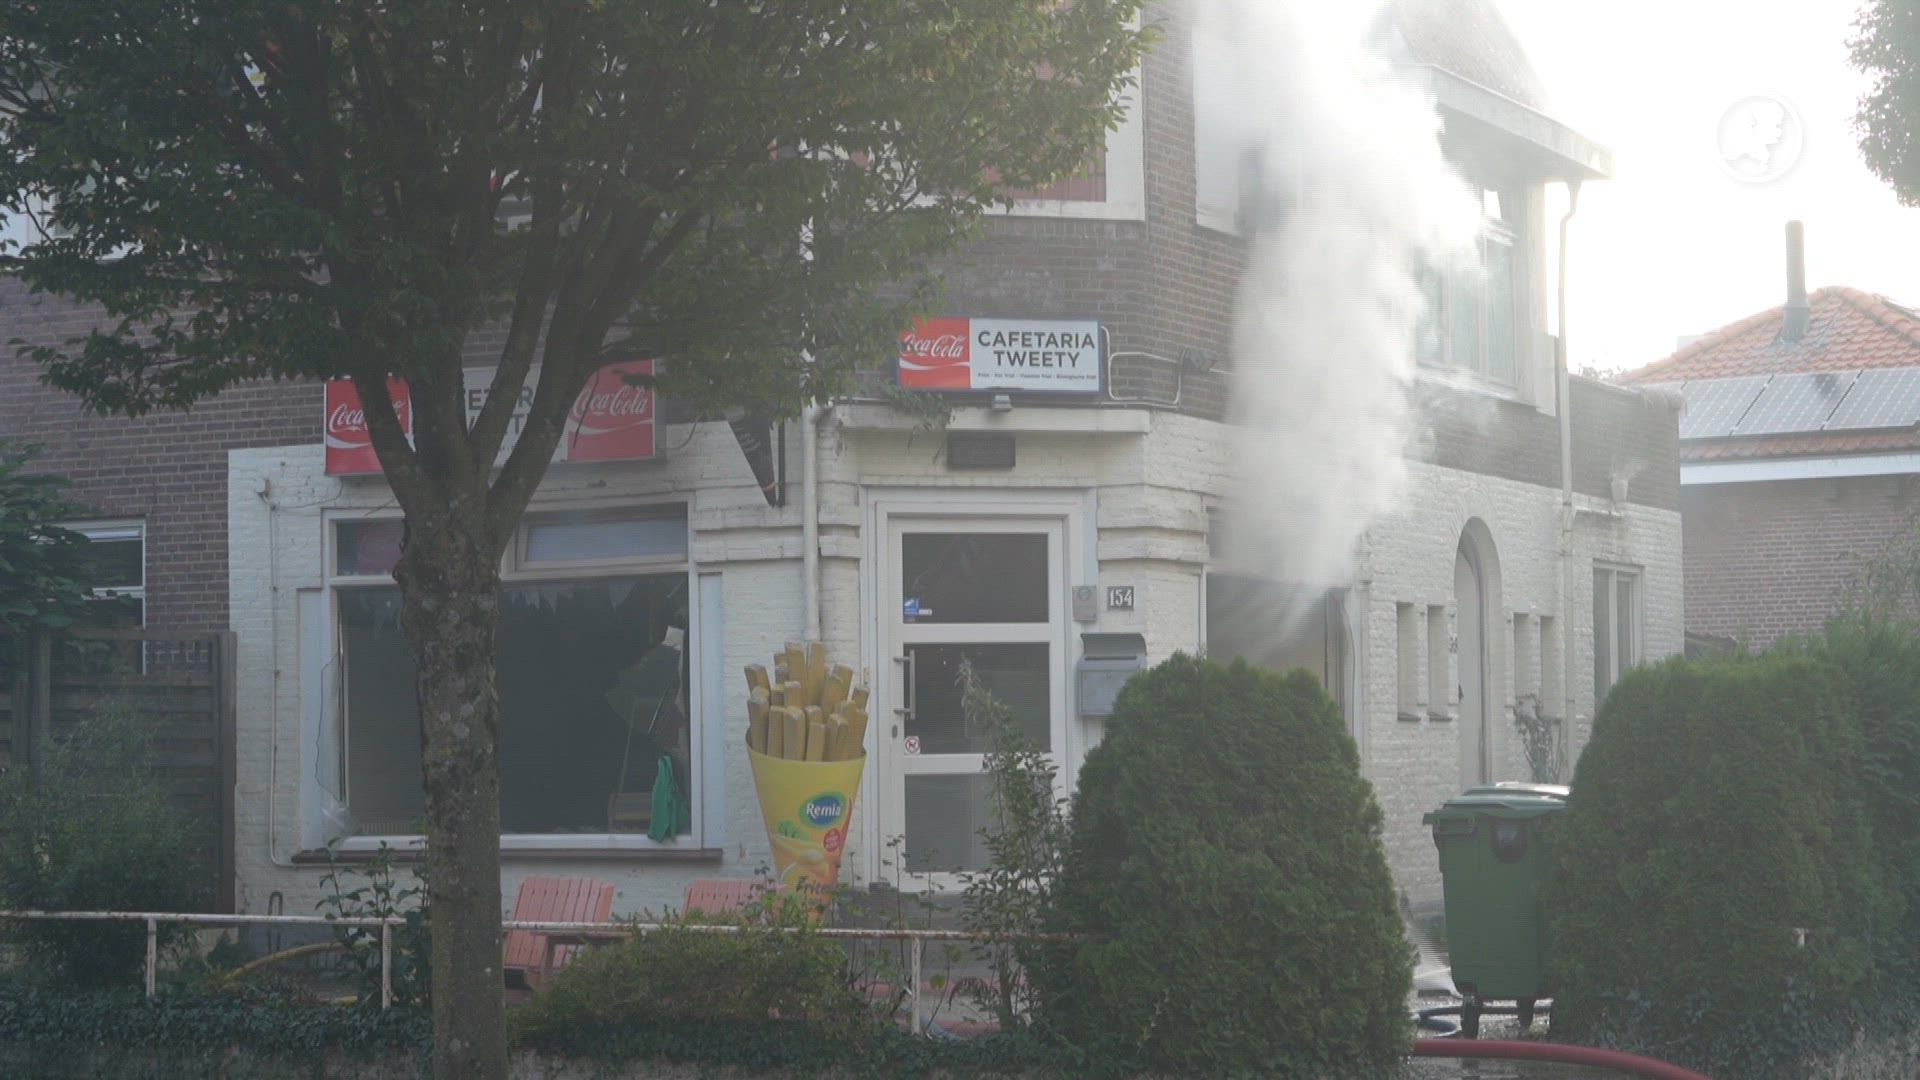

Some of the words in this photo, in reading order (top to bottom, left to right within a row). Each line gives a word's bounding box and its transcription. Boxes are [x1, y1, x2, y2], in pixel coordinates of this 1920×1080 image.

[978, 330, 1095, 349] CAFETARIA
[993, 351, 1080, 368] TWEETY
[1109, 589, 1132, 607] 154
[806, 802, 841, 819] Remia
